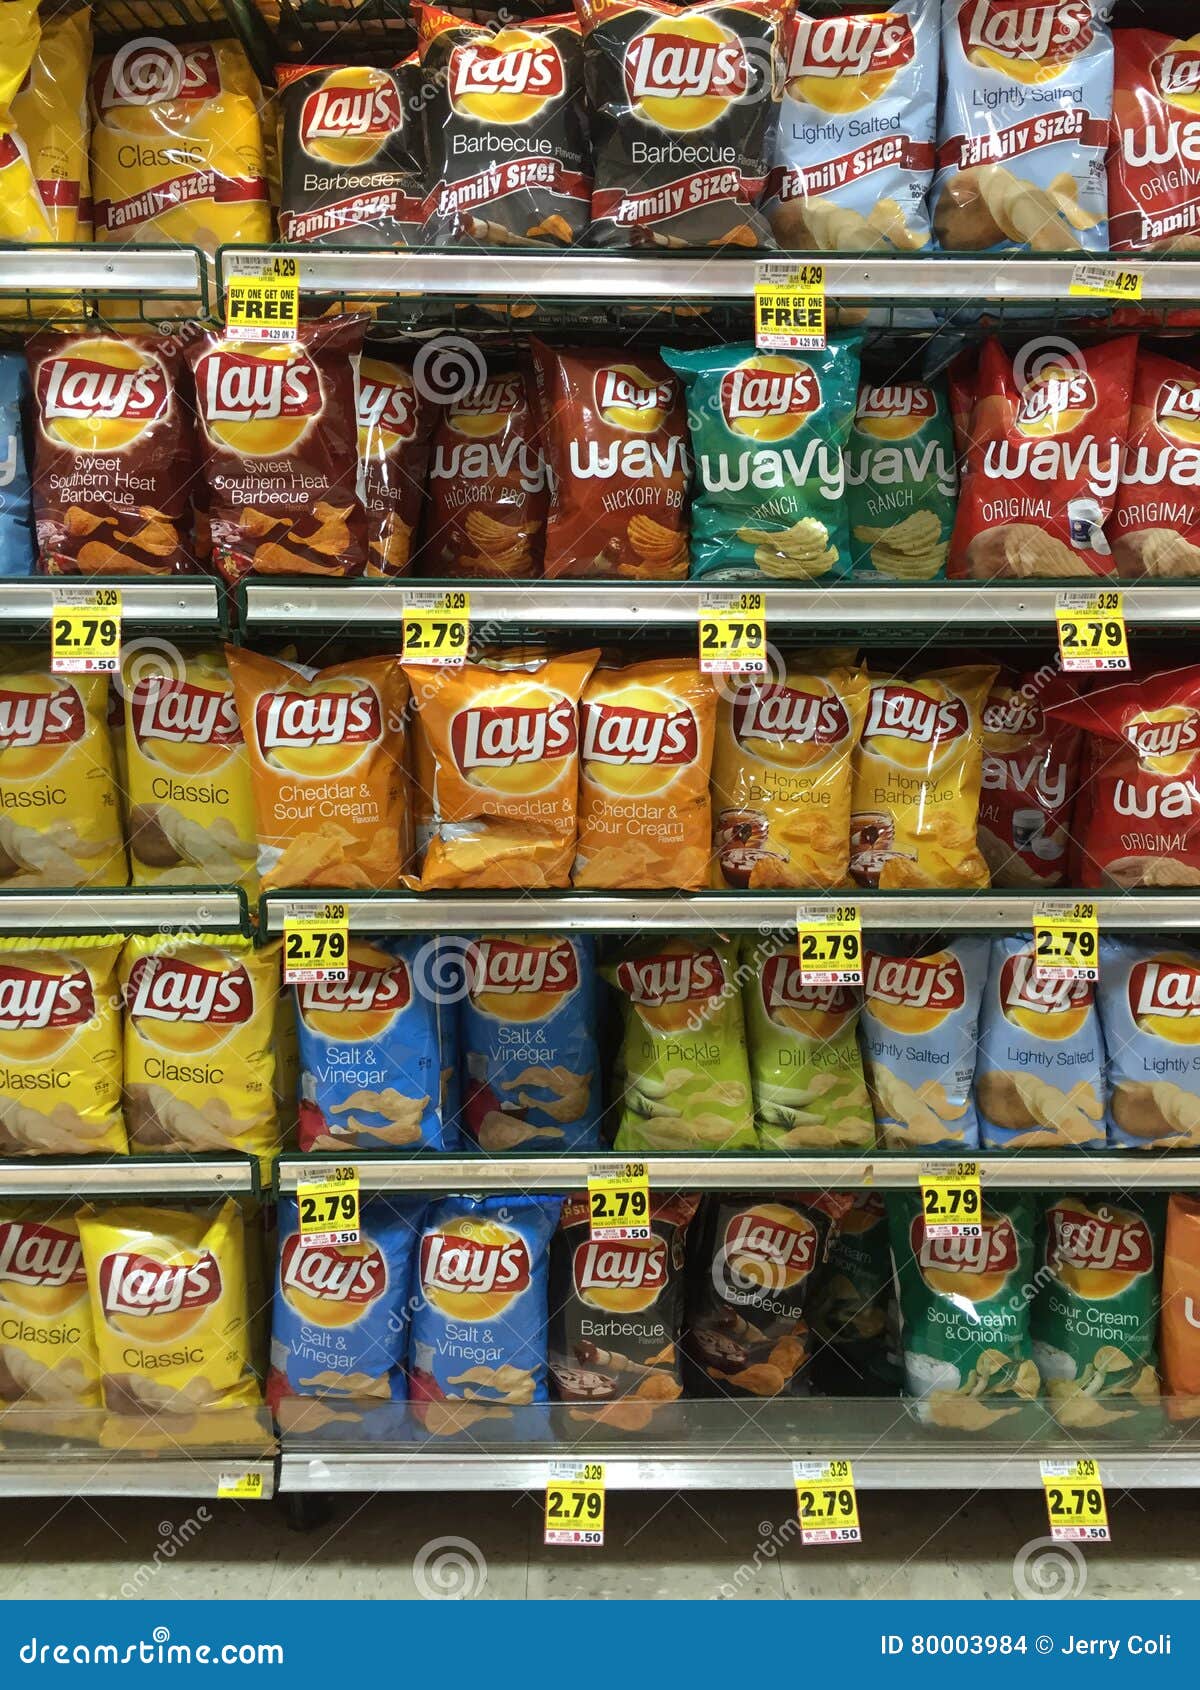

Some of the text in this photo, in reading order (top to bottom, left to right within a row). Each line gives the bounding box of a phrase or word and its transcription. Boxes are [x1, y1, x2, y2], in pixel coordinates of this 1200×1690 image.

[789, 17, 906, 78] Lay's
[454, 46, 554, 96] Lay's
[634, 37, 738, 98] Lay's
[973, 87, 1028, 109] Lightly
[306, 86, 393, 138] Lay's
[792, 113, 900, 141] Lightly Salted
[1034, 112, 1083, 142] Size!
[453, 133, 552, 155] Barbecue
[632, 142, 736, 164] Barbecue
[117, 142, 204, 169] Classic
[782, 137, 903, 199] Family Size!
[304, 173, 395, 192] Barbecue
[438, 159, 555, 216] Family Size!
[106, 173, 217, 229] Family Size!
[618, 172, 740, 223] Family Size!
[273, 258, 296, 277] 4.29
[800, 266, 823, 284] 4.29
[1115, 272, 1138, 291] 4.29
[230, 288, 294, 299] BUY ONE GET ONE
[759, 296, 822, 308] BUY ONE GET ONE
[230, 300, 294, 320] FREE
[760, 308, 822, 327] FREE
[44, 360, 161, 419] Lay's
[206, 356, 311, 421] Lay's
[729, 371, 813, 418] Lay's
[74, 454, 122, 472] Sweet
[242, 458, 293, 474] Sweet
[700, 438, 845, 501] wavy
[982, 434, 1120, 497] wavy
[49, 473, 156, 492] Southern Heat
[214, 474, 330, 490] Southern Heat
[60, 488, 135, 506] Barbecue
[231, 489, 310, 505] Barbecue
[602, 487, 661, 512] HICKORY
[867, 490, 914, 516] RANCH
[982, 497, 1053, 522] ORIGINAL
[1117, 502, 1196, 528] ORIGINAL
[95, 590, 118, 606] 3.29
[445, 592, 466, 609] 3.29
[741, 594, 761, 610] 3.29
[1097, 593, 1119, 610] 3.29
[55, 620, 117, 647] 2.79
[405, 622, 466, 649] 2.79
[702, 623, 762, 649] 2.79
[1061, 622, 1123, 647] 2.79
[93, 660, 116, 670] .50
[740, 661, 763, 671] .50
[1103, 659, 1127, 669] .50
[139, 681, 241, 743] Lay's
[264, 692, 374, 748] Lay's
[739, 686, 839, 742] Lay's
[864, 688, 960, 743] Lay's
[463, 703, 574, 768] Lay's
[581, 704, 692, 765] Lay's
[152, 777, 230, 805] Classic
[764, 770, 817, 790] Honey
[887, 772, 938, 792] Honey
[278, 784, 371, 801] Cheddar &
[749, 786, 831, 804] Barbecue
[873, 787, 954, 806] Barbecue
[273, 801, 379, 821] Sour Cream
[482, 798, 573, 816] Cheddar &
[591, 800, 678, 819] Cheddar &
[586, 814, 623, 834] Sour
[626, 819, 684, 836] Cream
[1120, 833, 1188, 852] ORIGINAL
[325, 904, 345, 919] 3.29
[836, 906, 856, 921] 3.29
[1073, 903, 1093, 918] 3.29
[287, 932, 345, 959] 2.79
[801, 934, 859, 960] 2.79
[1037, 930, 1095, 957] 2.79
[323, 970, 346, 981] .50
[468, 943, 571, 998] Lay's
[626, 953, 715, 1007] Lay's
[838, 972, 861, 983] .50
[866, 955, 957, 1007] Lay's
[1073, 969, 1096, 979] .50
[132, 956, 245, 1022] Lay's
[497, 1027, 547, 1045] Salt &
[326, 1048, 377, 1065] Salt &
[489, 1046, 558, 1064] Vinegar
[666, 1042, 720, 1062] Pickle
[777, 1048, 805, 1067] Dill
[906, 1046, 950, 1065] Salted
[1007, 1047, 1094, 1067] Lightly Salted
[144, 1058, 224, 1084] Classic
[316, 1066, 388, 1087] Vinegar
[1143, 1057, 1190, 1074] Lightly
[335, 1167, 355, 1181] 3.29
[625, 1163, 644, 1177] 3.29
[957, 1162, 976, 1176] 3.29
[301, 1194, 356, 1223] 2.79
[591, 1191, 647, 1218] 2.79
[924, 1189, 978, 1214] 2.79
[337, 1232, 358, 1243] .50
[627, 1228, 648, 1239] .50
[728, 1214, 815, 1267] Lay's
[958, 1226, 980, 1236] .50
[288, 1247, 377, 1300] Lay's
[424, 1235, 522, 1294] Lay's
[580, 1243, 666, 1293] Lay's
[106, 1250, 211, 1317] Lay's
[723, 1285, 802, 1320] Barbecue
[1048, 1297, 1139, 1328] Sour Cream
[581, 1318, 664, 1338] Barbecue
[927, 1308, 1017, 1327] Sour Cream
[1, 1319, 81, 1345] Classic
[300, 1325, 347, 1351] Salt &
[445, 1322, 494, 1344] Salt &
[945, 1325, 1003, 1343] & Onion
[1064, 1321, 1123, 1341] & Onion
[123, 1345, 204, 1370] Classic
[291, 1338, 356, 1369] Vinegar
[435, 1337, 504, 1364] Vinegar
[584, 1464, 602, 1480] 3.29
[829, 1461, 848, 1477] 3.29
[1076, 1460, 1095, 1476] 3.29
[548, 1491, 602, 1519] 2.79
[800, 1489, 854, 1517] 2.79
[1048, 1489, 1102, 1515] 2.79
[580, 1532, 601, 1543] .50
[837, 1528, 858, 1540] .50
[1087, 1528, 1107, 1538] .50
